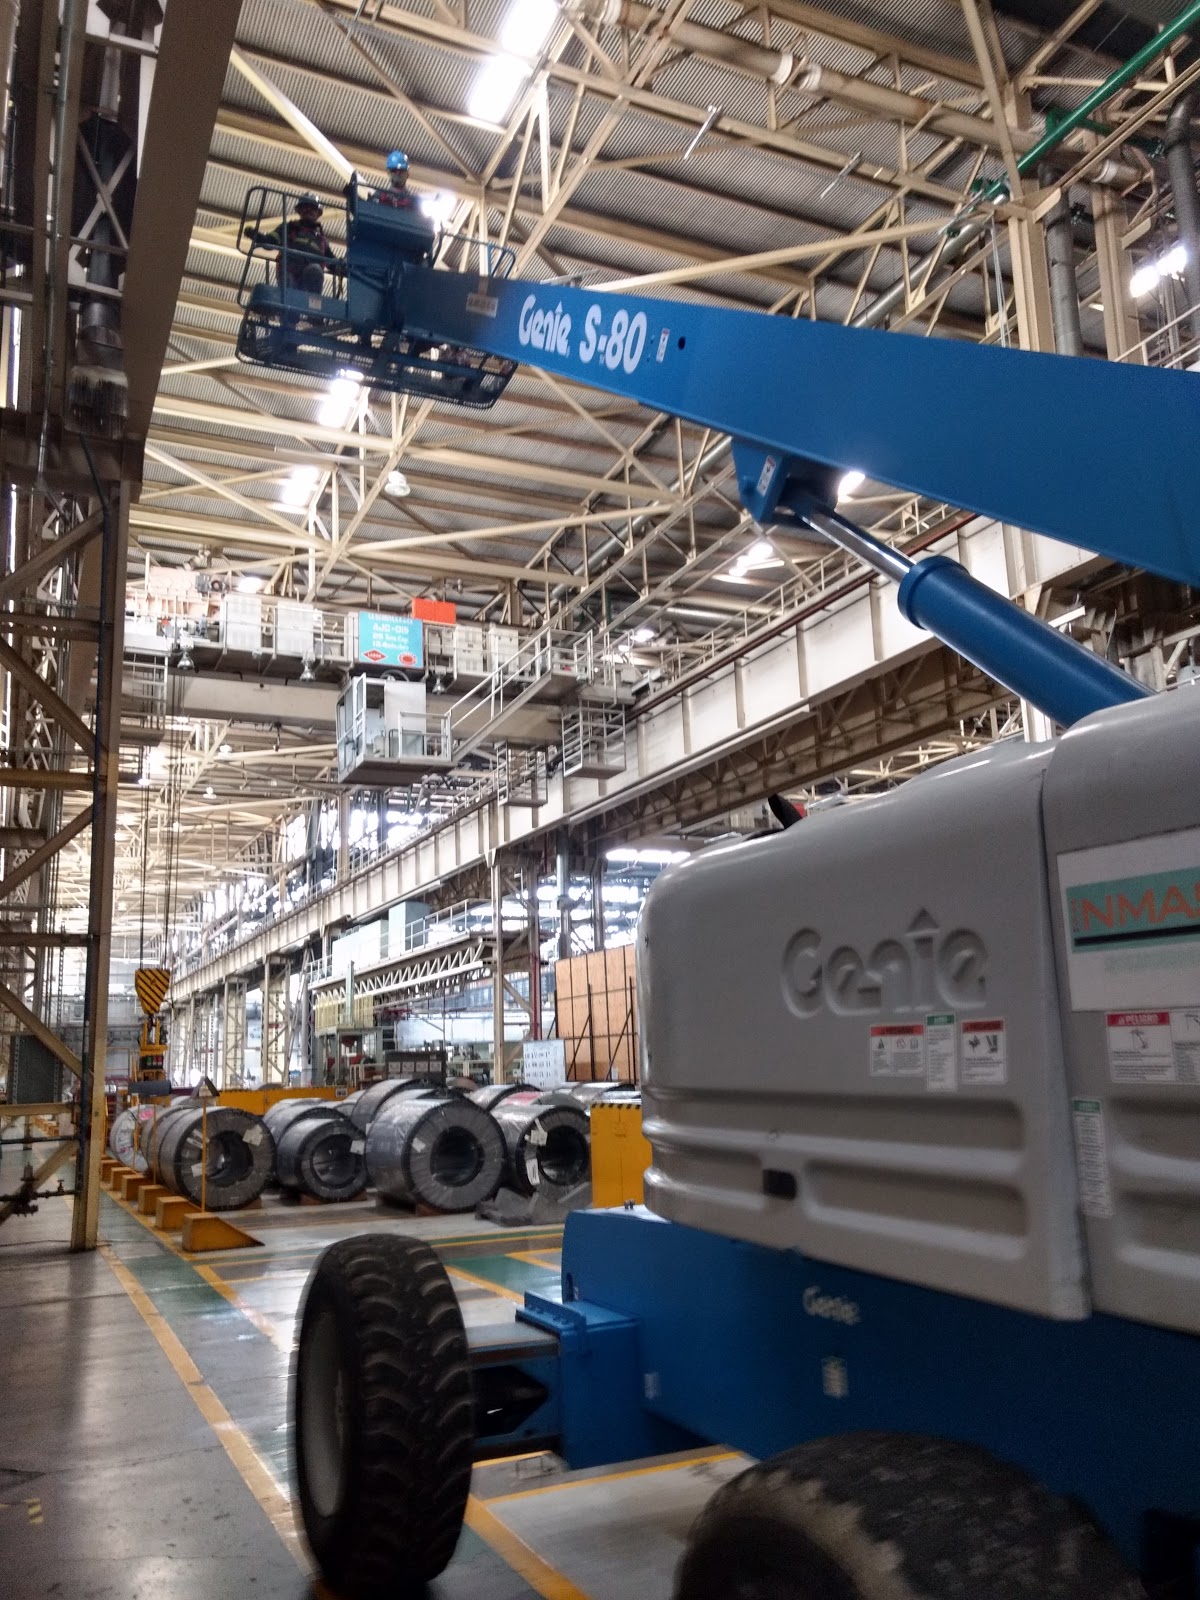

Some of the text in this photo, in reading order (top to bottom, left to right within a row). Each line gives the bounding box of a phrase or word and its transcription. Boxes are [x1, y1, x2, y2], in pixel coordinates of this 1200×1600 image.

[519, 294, 571, 356] Genie
[579, 304, 647, 374] S-80
[781, 908, 988, 1019] Genie
